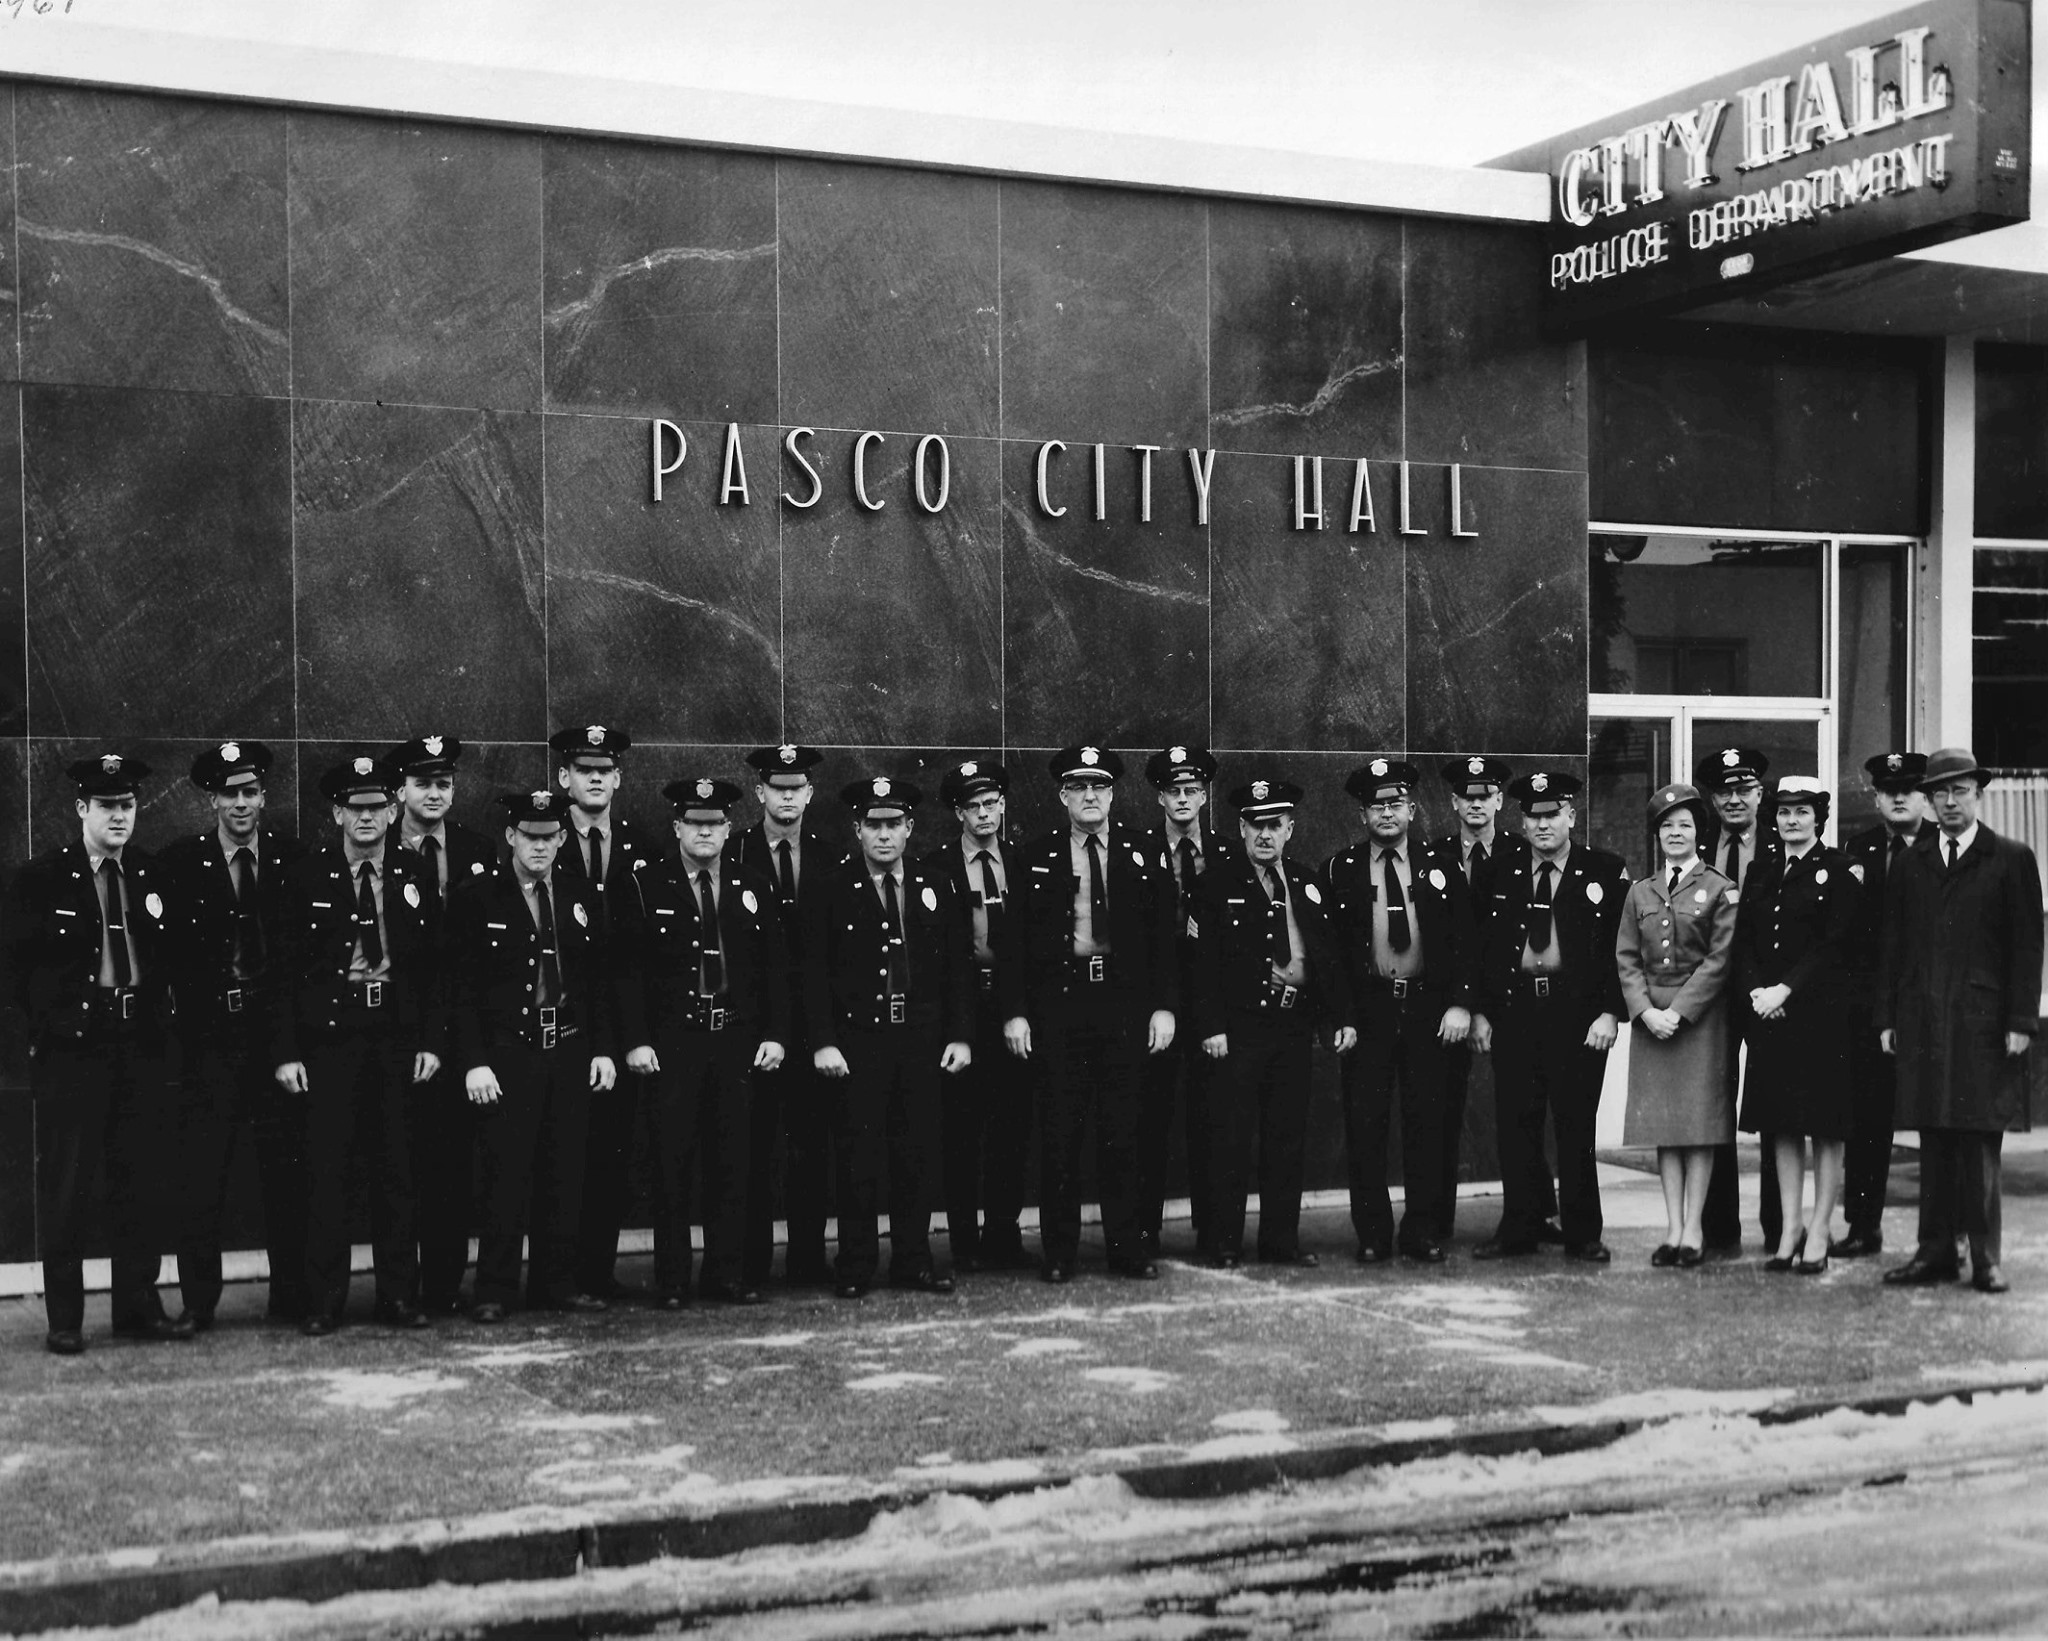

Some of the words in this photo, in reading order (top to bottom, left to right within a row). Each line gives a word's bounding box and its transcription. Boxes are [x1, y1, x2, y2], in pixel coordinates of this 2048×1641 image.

[1559, 99, 1727, 227] CITY
[1737, 26, 1950, 171] HALL
[1551, 221, 1669, 291] POLICE
[1689, 133, 1954, 250] DEPARTMENT
[652, 418, 951, 513] PASCO
[1036, 439, 1216, 526] CITY
[1294, 455, 1480, 538] HALL
